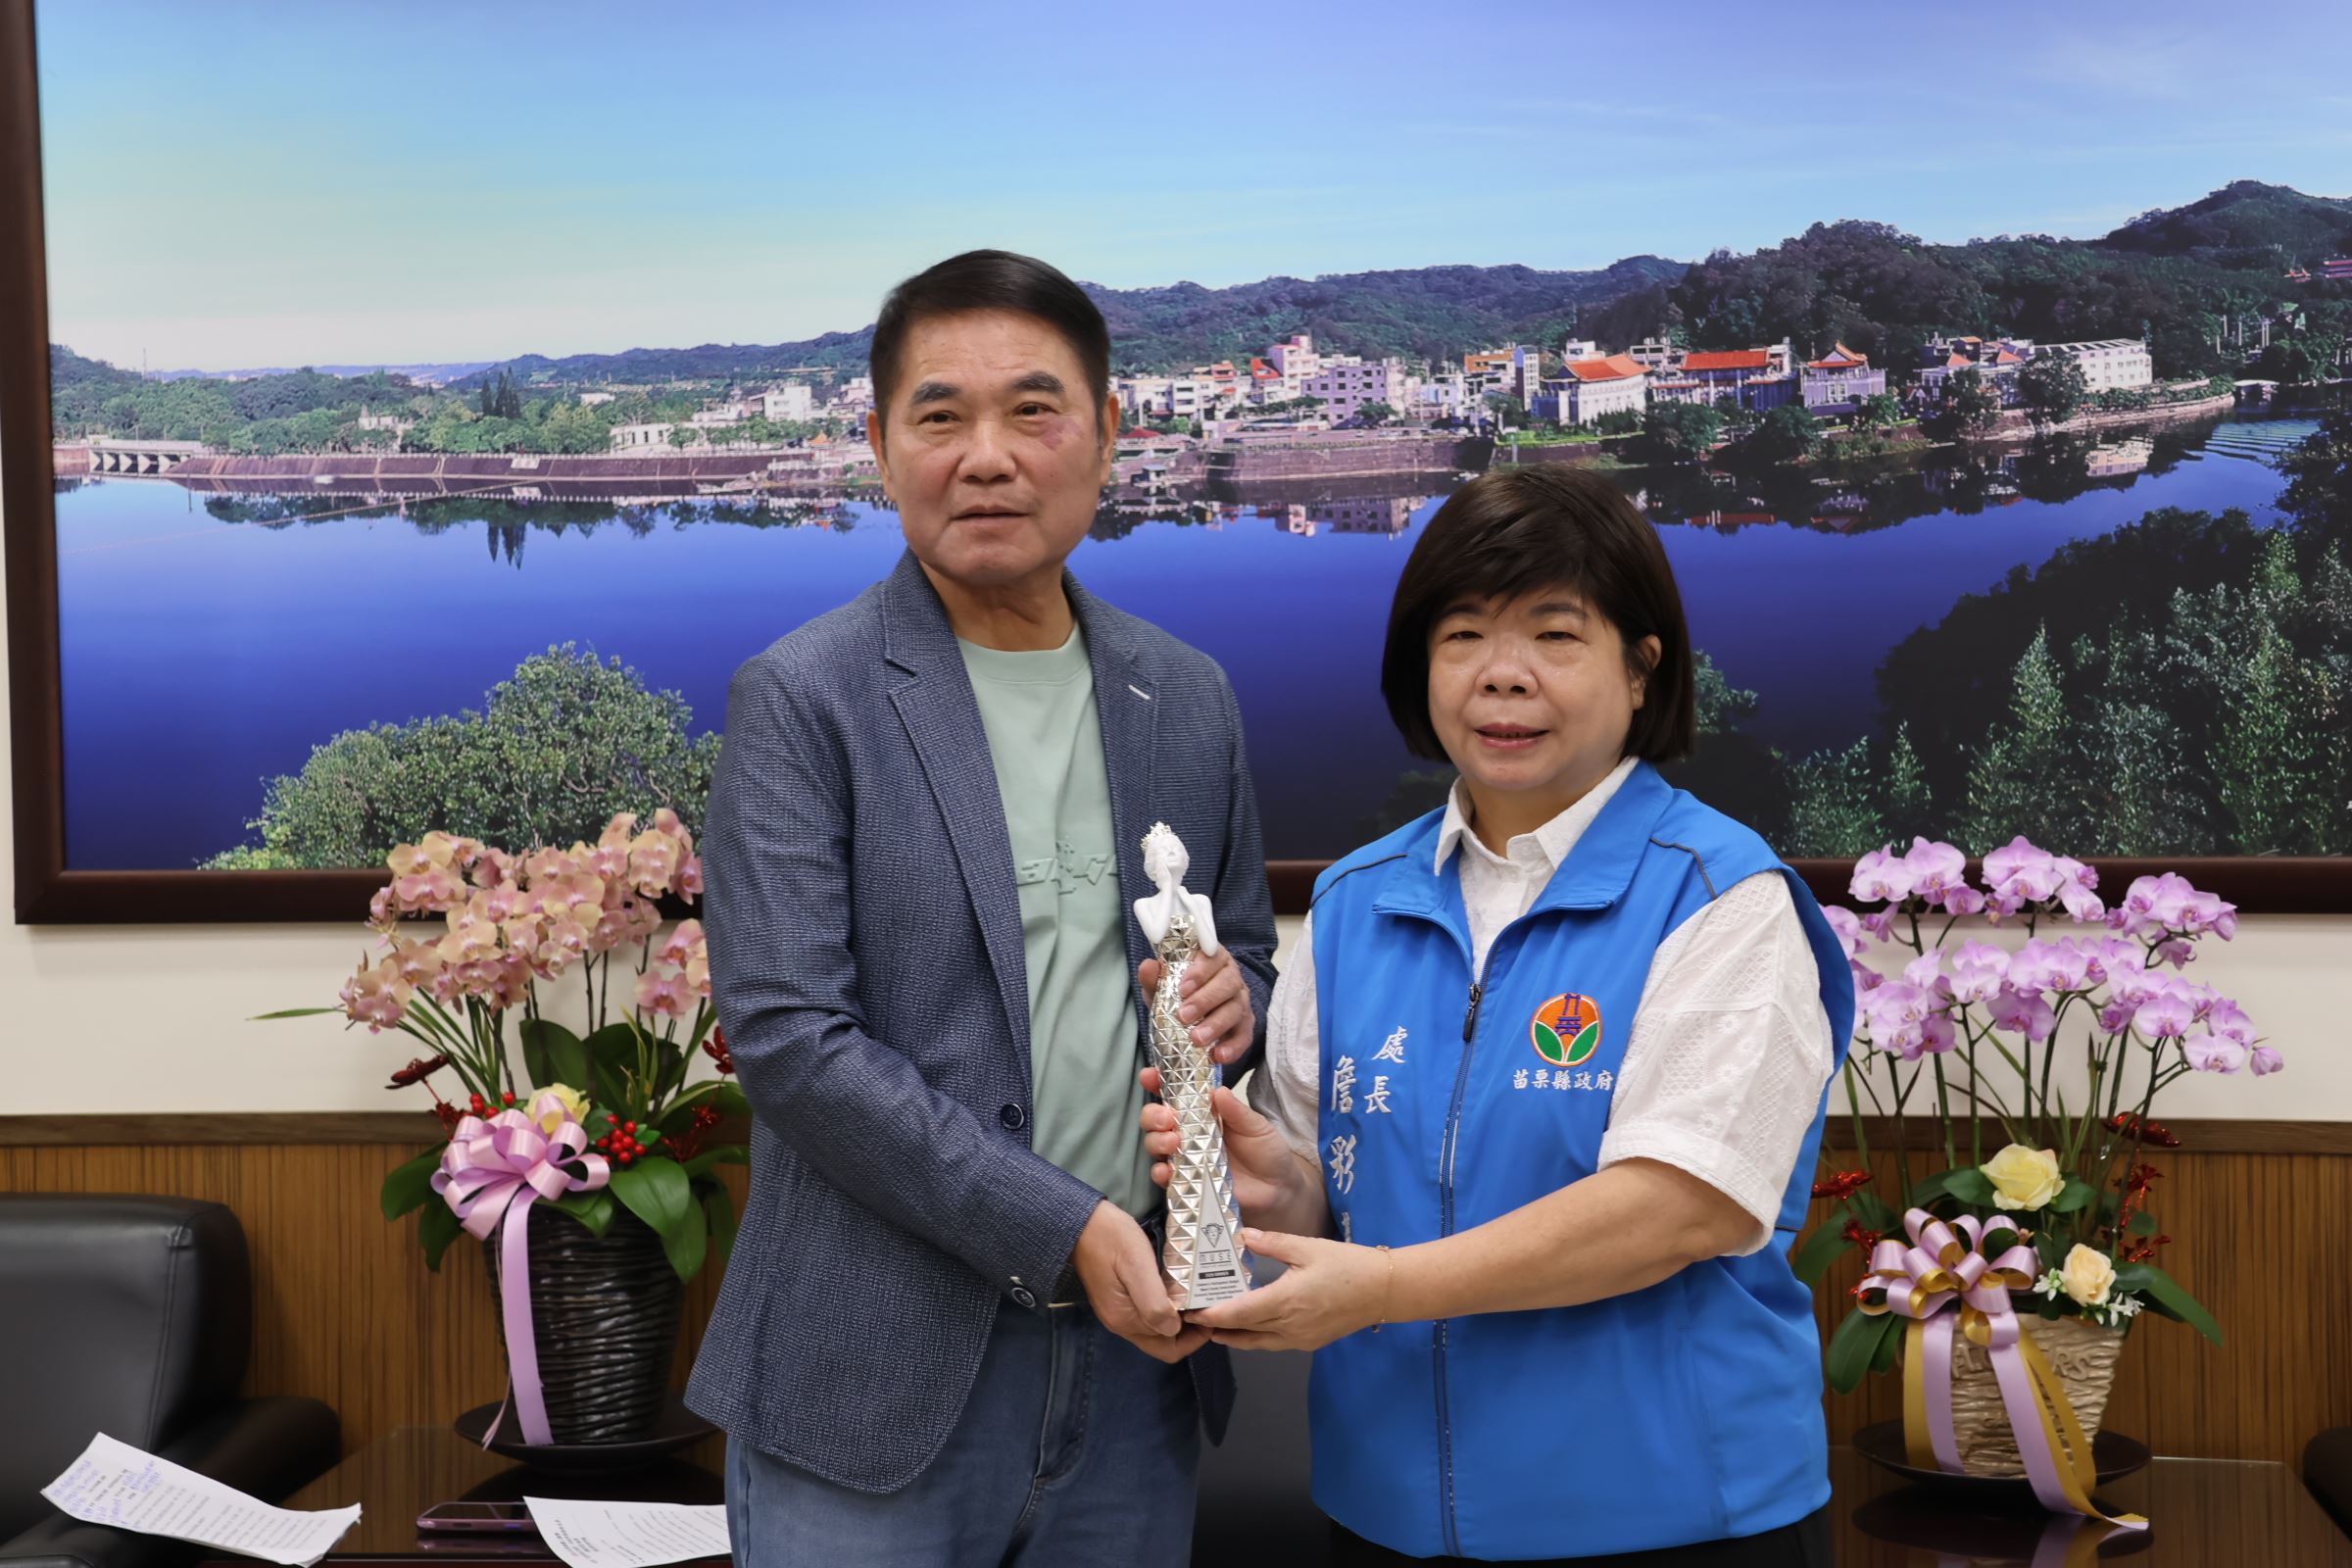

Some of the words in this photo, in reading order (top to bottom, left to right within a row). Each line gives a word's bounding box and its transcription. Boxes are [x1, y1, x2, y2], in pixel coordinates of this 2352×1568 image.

[1364, 1025, 1408, 1114] 處長
[1512, 1068, 1614, 1091] 苗栗縣政府
